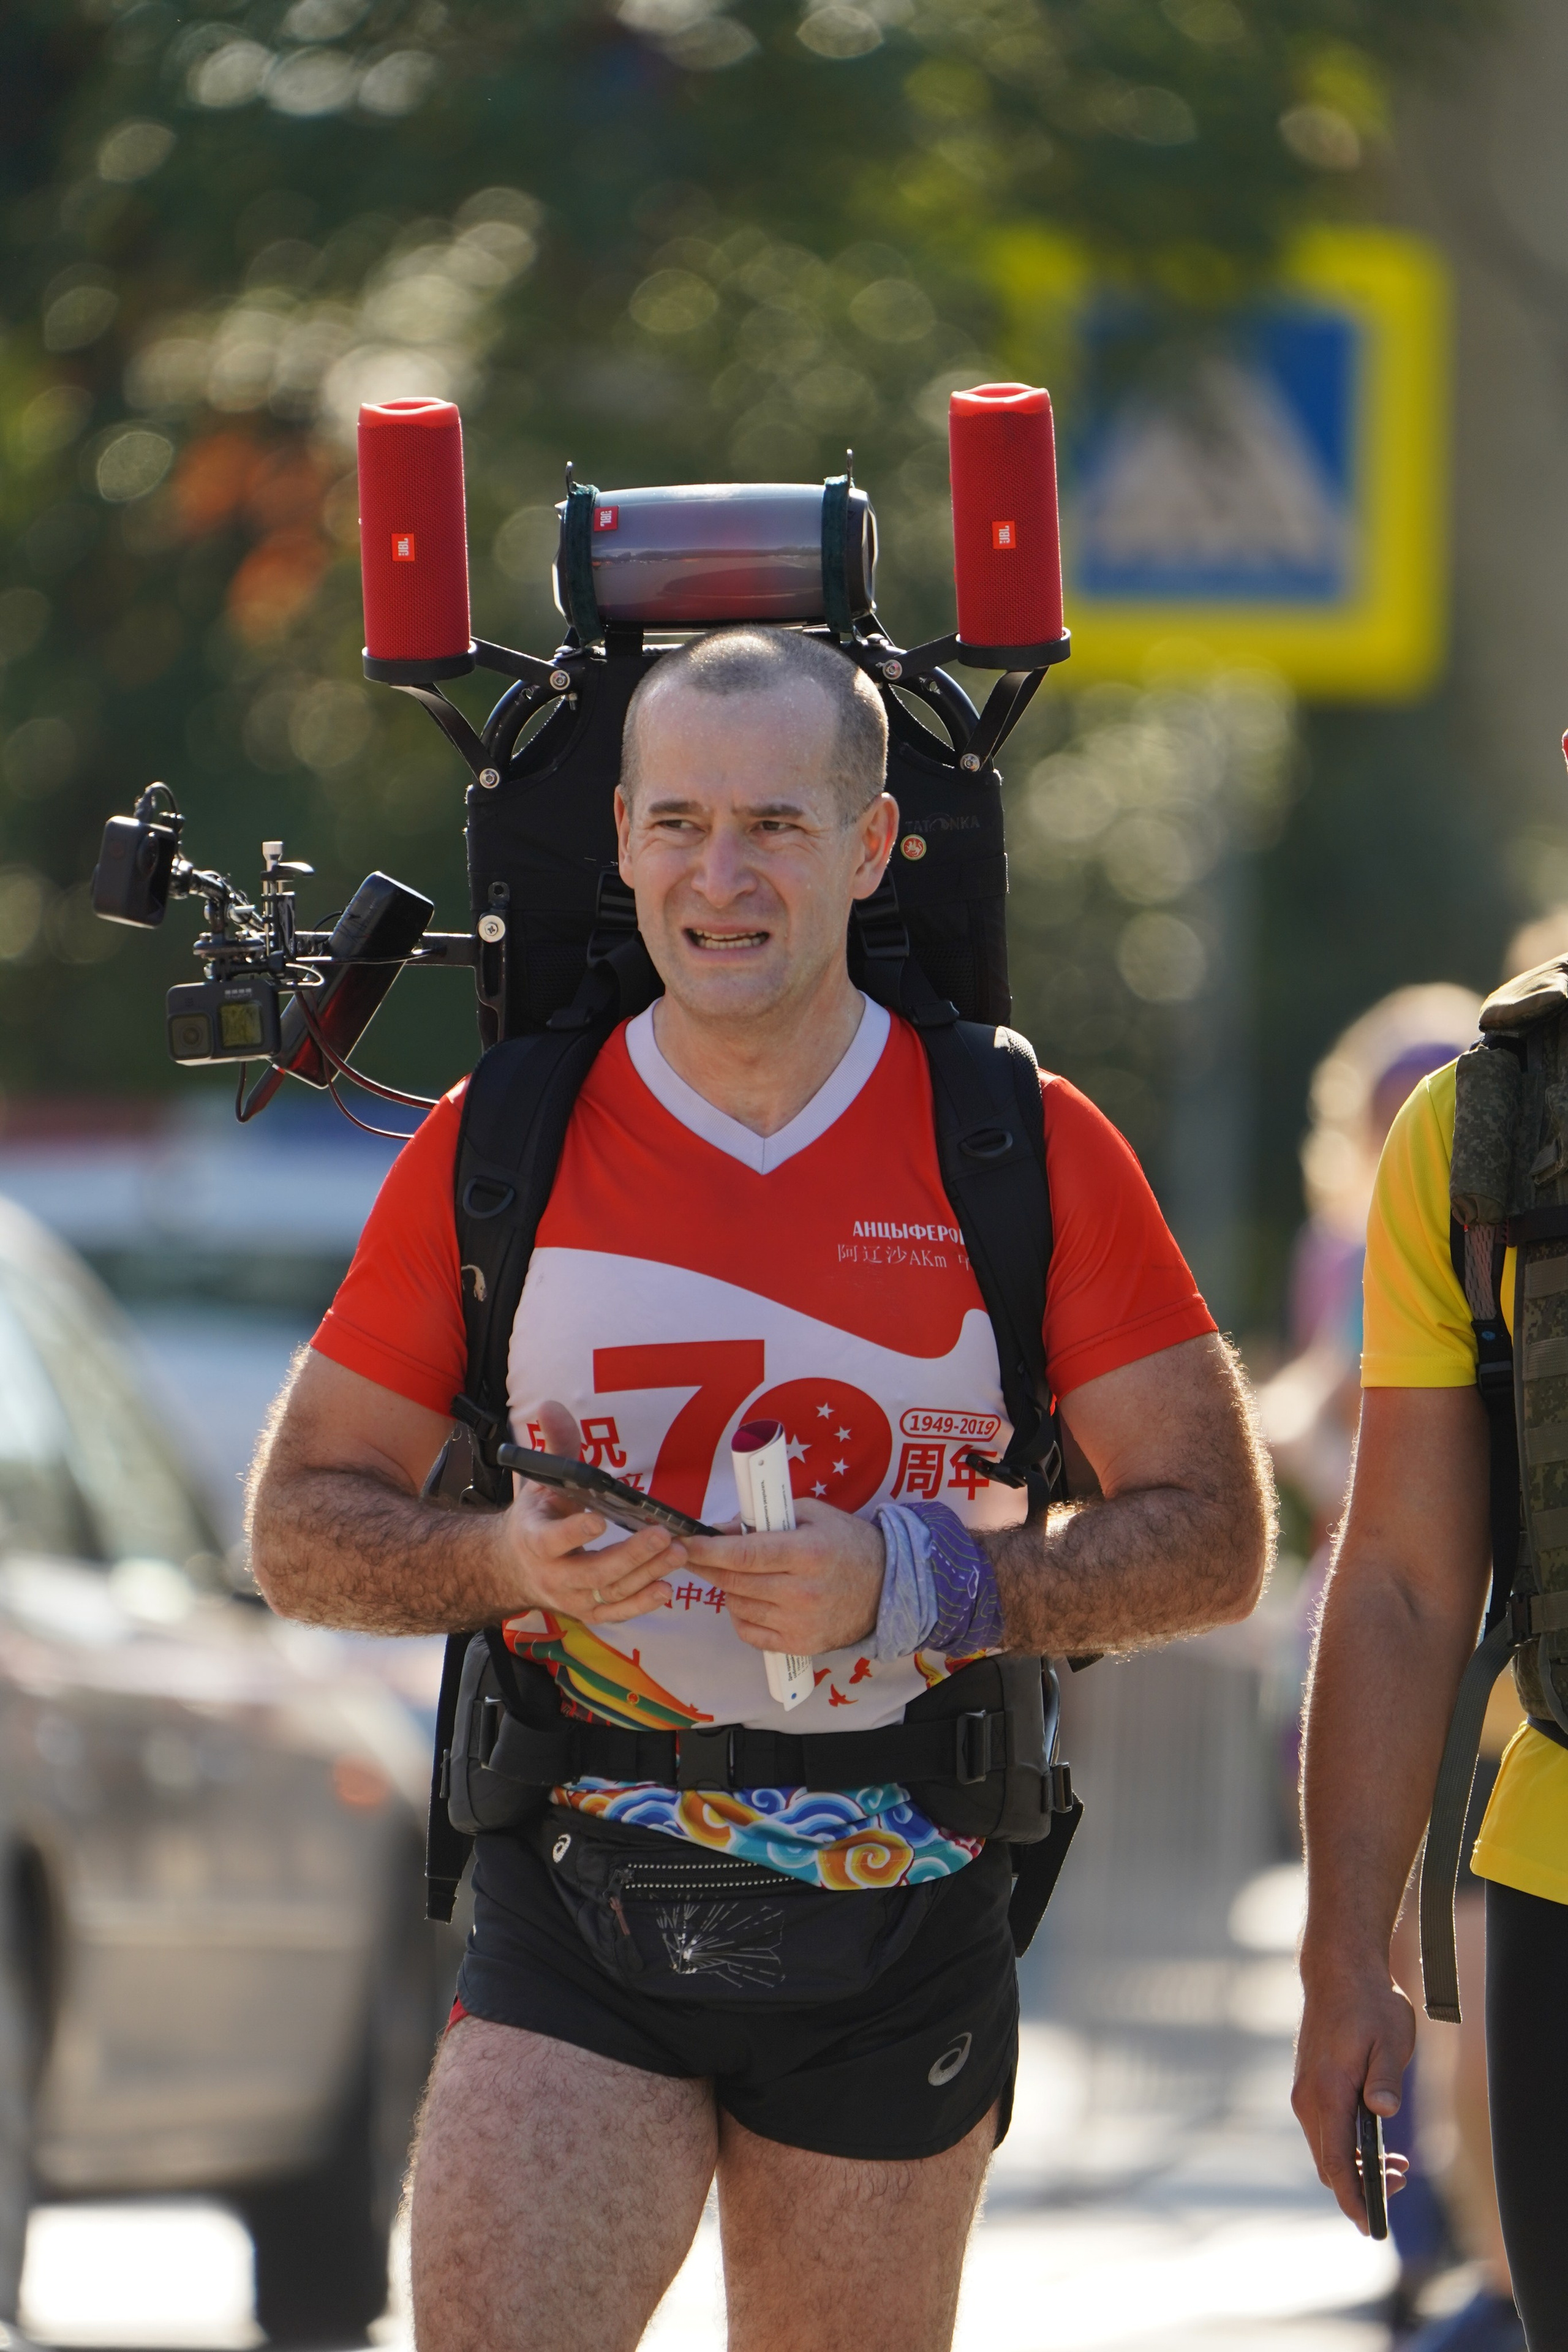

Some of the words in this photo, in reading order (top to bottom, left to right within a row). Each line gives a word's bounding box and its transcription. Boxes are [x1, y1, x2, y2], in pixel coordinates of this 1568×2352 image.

[600, 510, 612, 527] JBL
[999, 525, 1011, 545] JBL
[398, 537, 409, 557] JBL
[910, 1415, 995, 1436] 1949-2019
[889, 1442, 998, 1501] 周年
[663, 1579, 727, 1614] 中华
